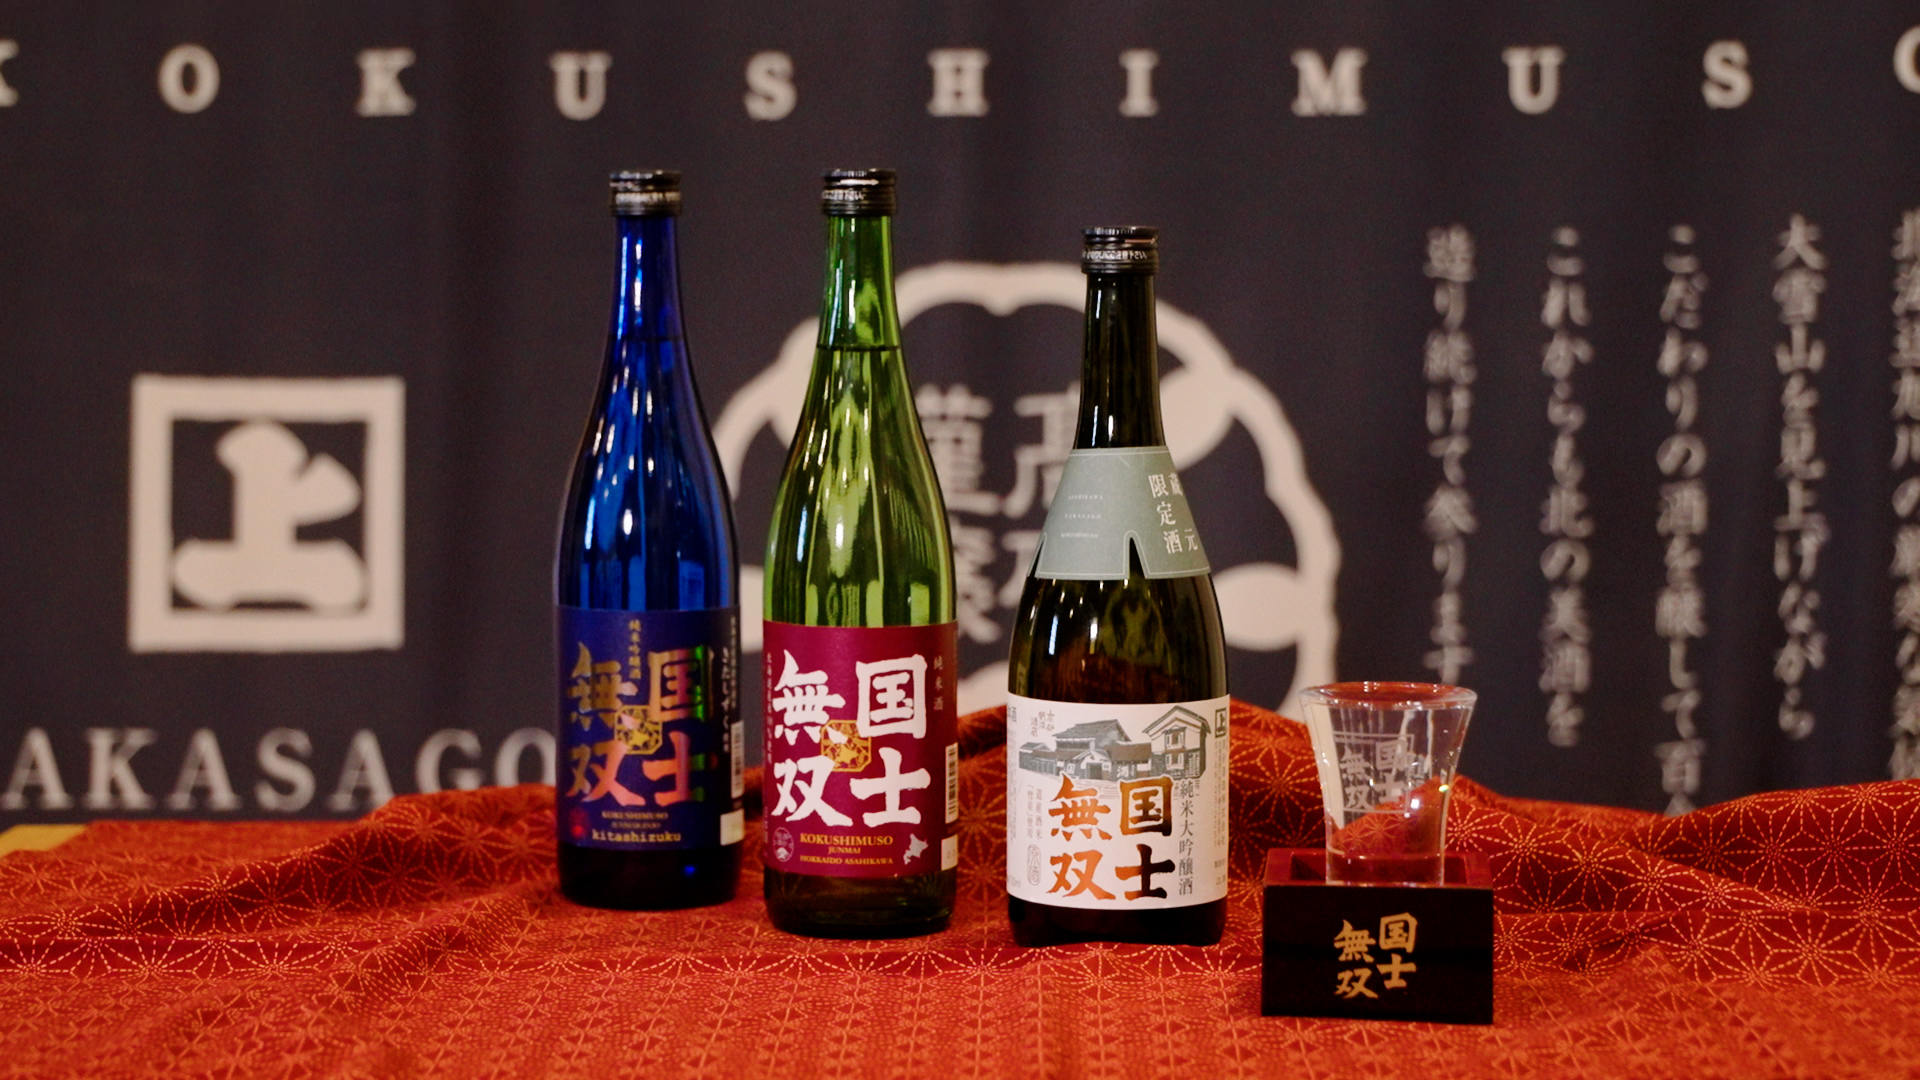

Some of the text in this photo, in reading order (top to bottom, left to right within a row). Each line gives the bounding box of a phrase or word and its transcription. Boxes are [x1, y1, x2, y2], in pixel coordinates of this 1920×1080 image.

[1148, 473, 1183, 555] 限定酒
[1540, 226, 1594, 746] これからも北の美酒を
[1772, 213, 1830, 740] 大雪山を見上げながら
[771, 648, 854, 827] 無双
[850, 652, 932, 828] 国士
[591, 829, 683, 843] kitashizuku
[799, 832, 894, 847] KOKUSHIMUSO
[827, 846, 862, 855] JUNMAI
[1046, 773, 1117, 901] 無双
[1115, 775, 1176, 901] 国士
[1178, 779, 1194, 896] 純米大吟醸酒
[1333, 919, 1379, 999] 無双
[1376, 911, 1418, 990] 国士
